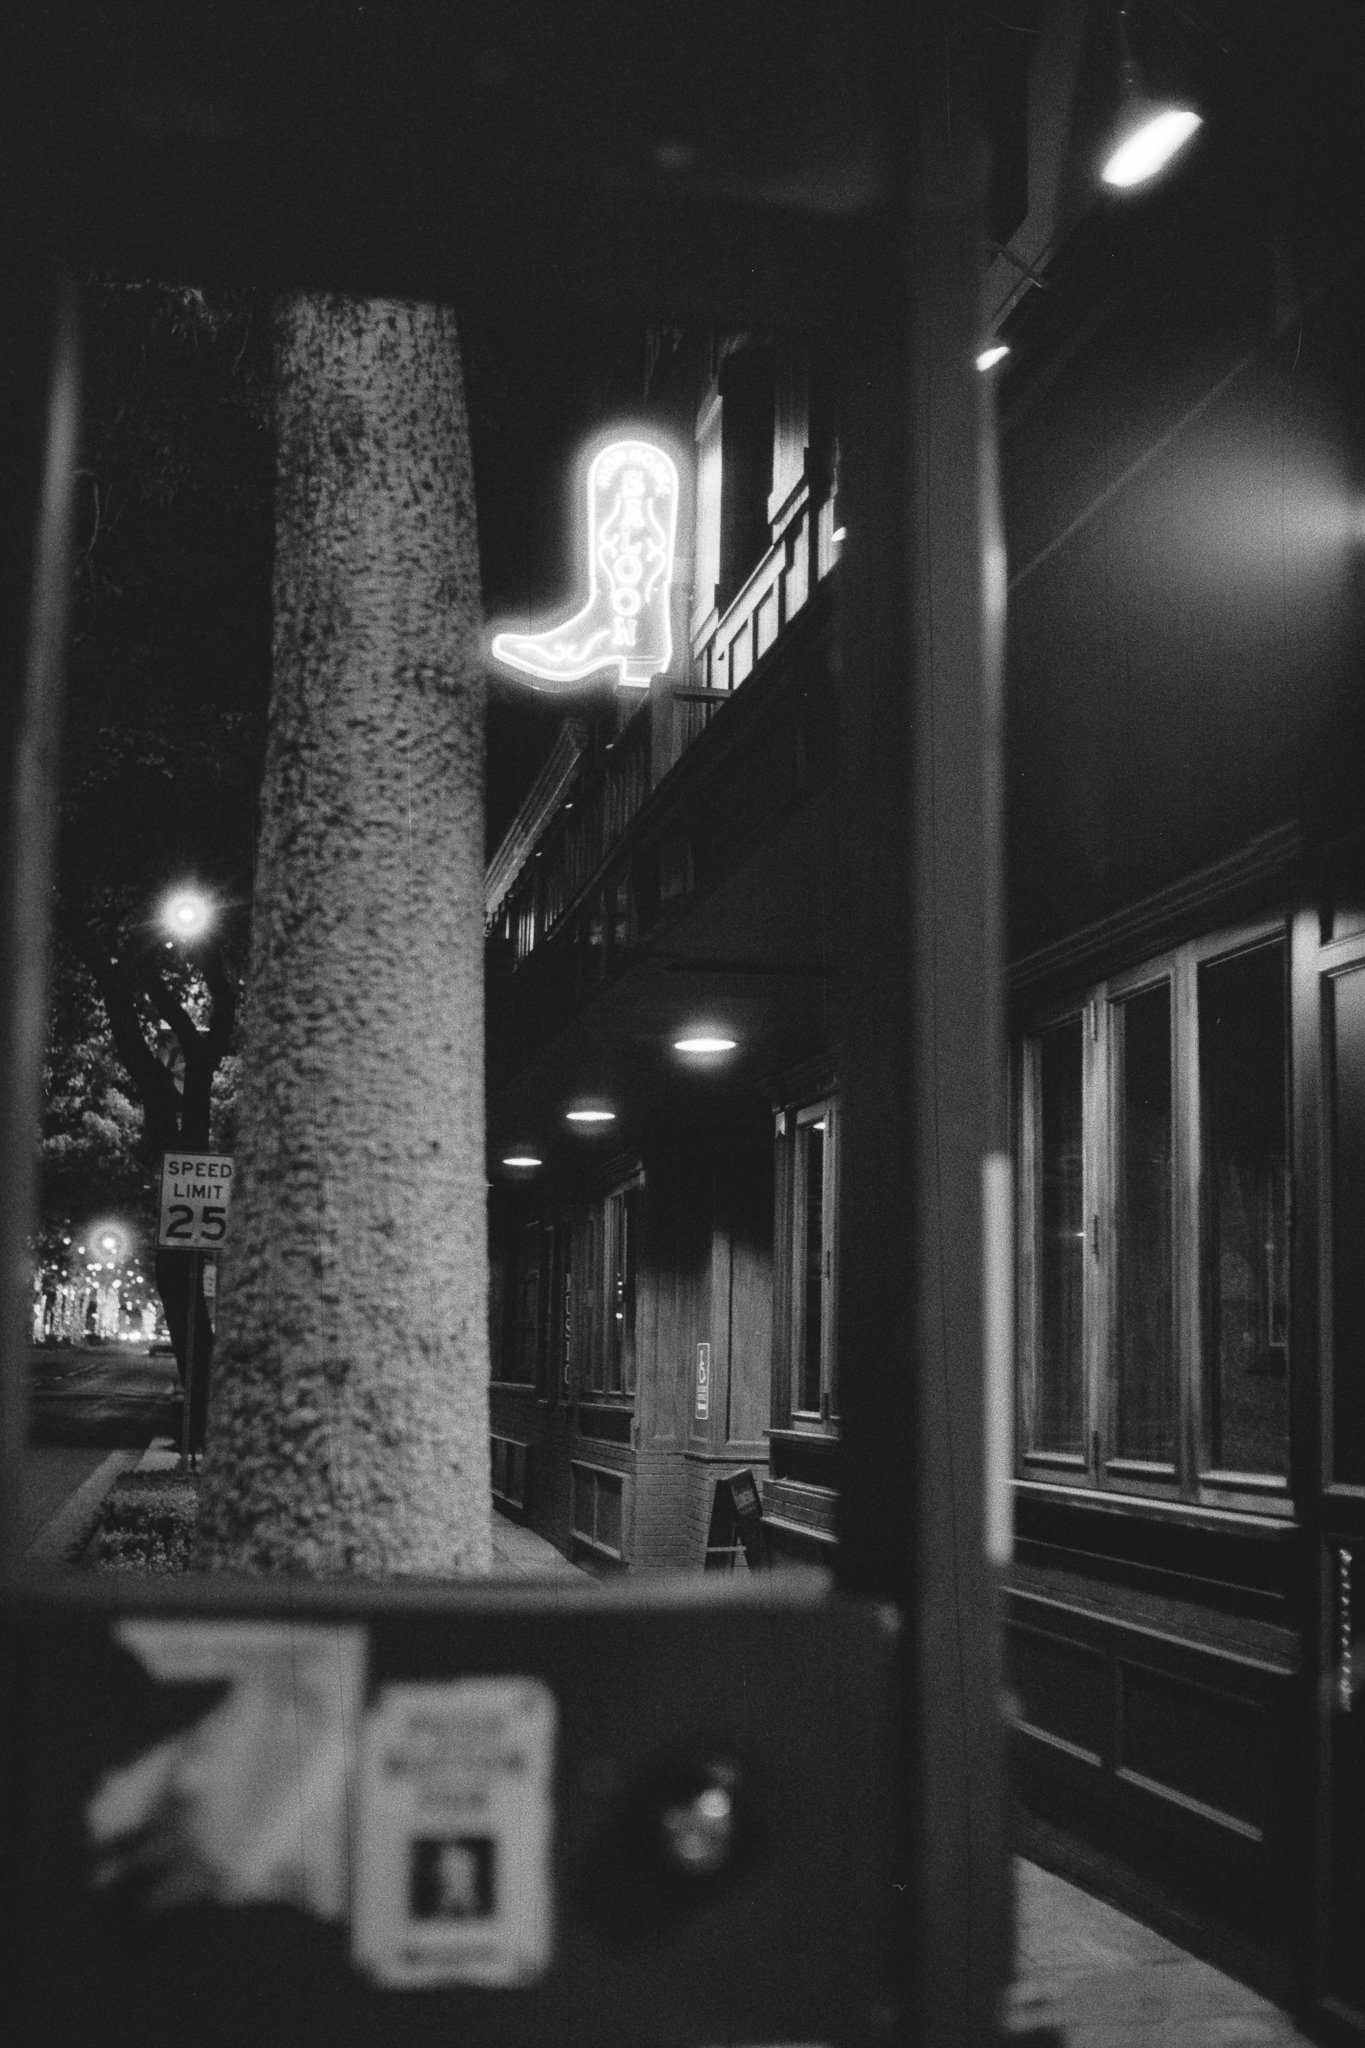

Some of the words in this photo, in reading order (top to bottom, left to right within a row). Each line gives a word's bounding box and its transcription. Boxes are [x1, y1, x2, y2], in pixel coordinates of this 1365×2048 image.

[612, 469, 646, 647] SALOON
[168, 1161, 232, 1178] SPEED
[173, 1182, 224, 1200] LIMIT
[165, 1204, 227, 1241] 25
